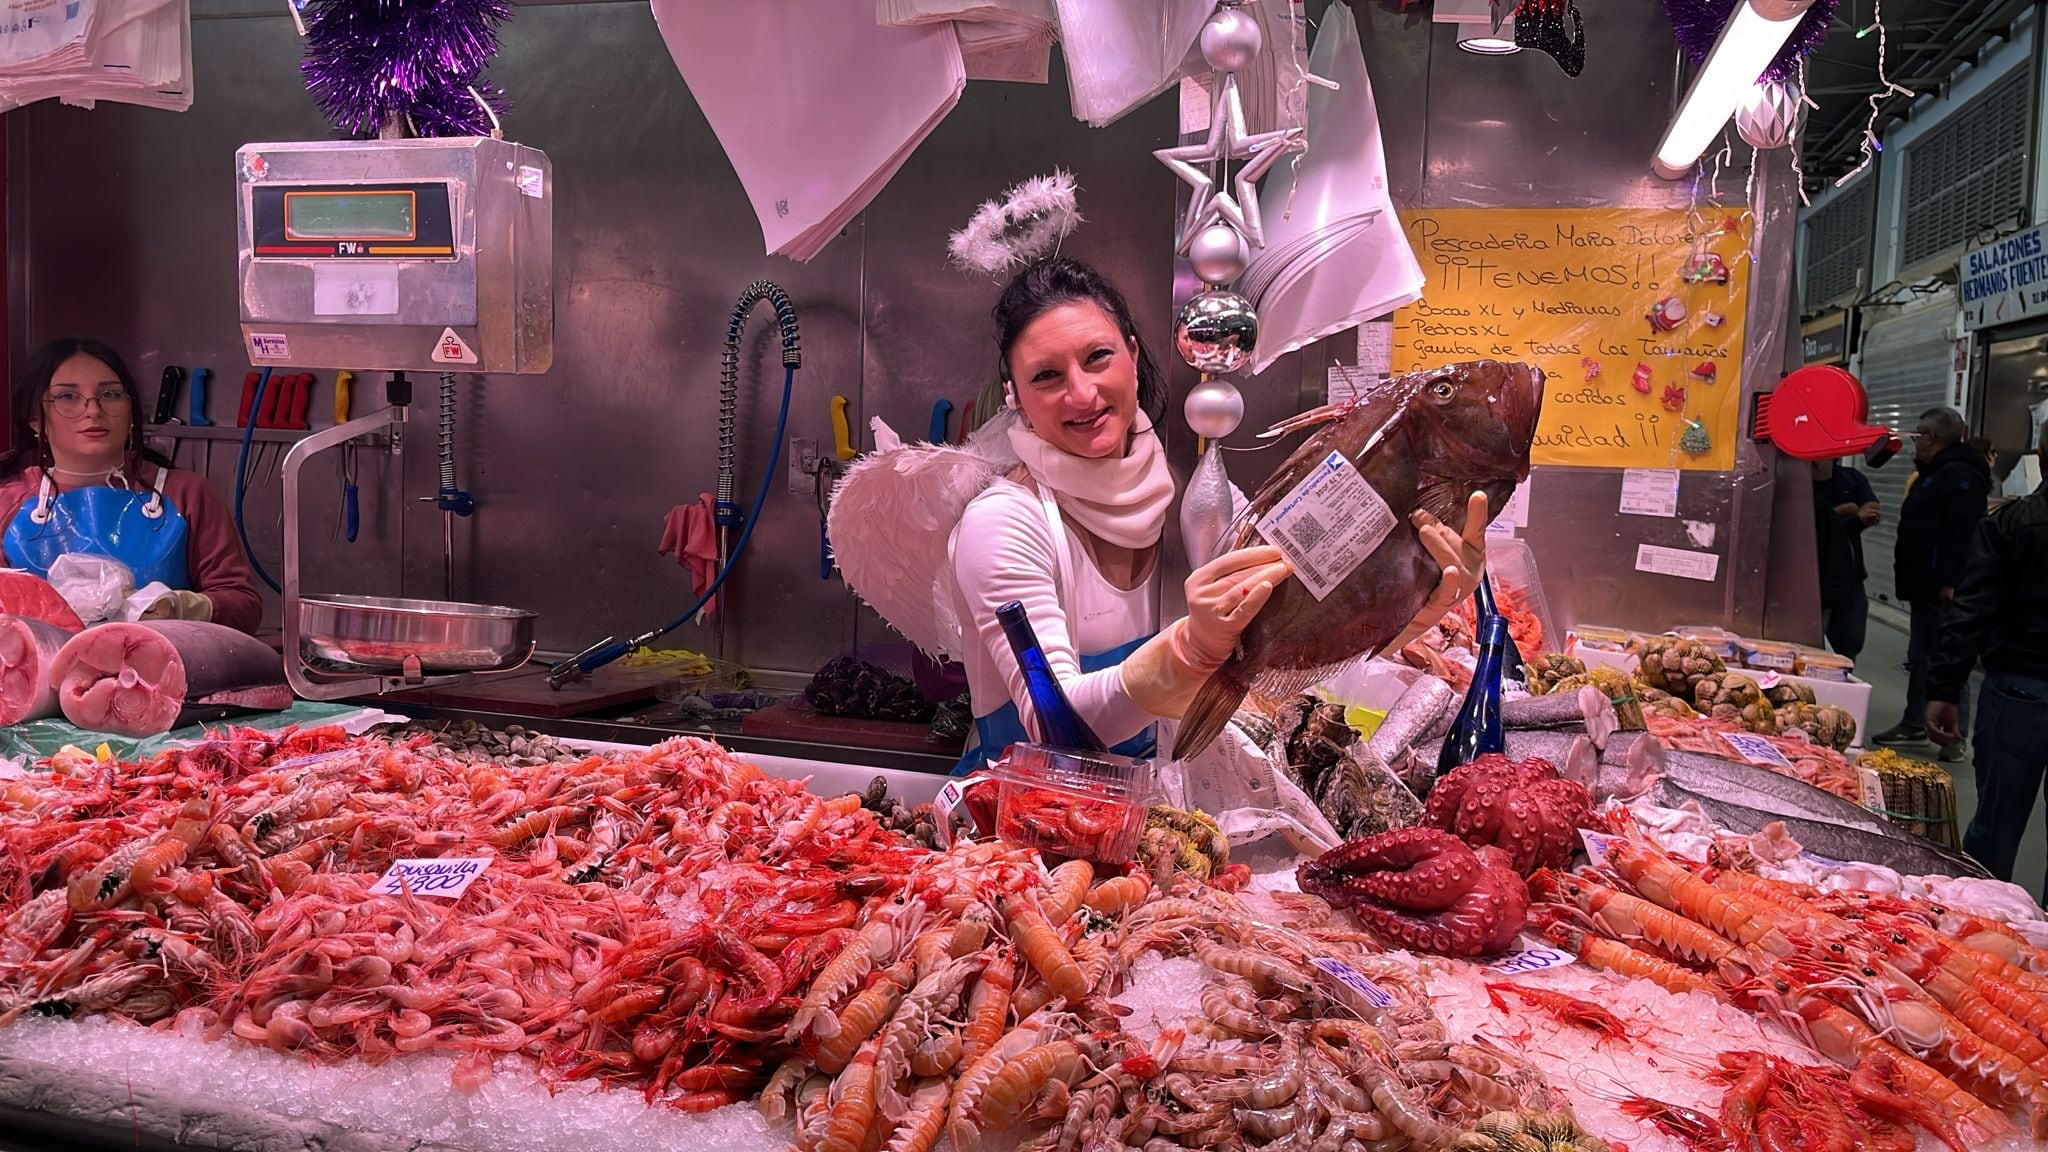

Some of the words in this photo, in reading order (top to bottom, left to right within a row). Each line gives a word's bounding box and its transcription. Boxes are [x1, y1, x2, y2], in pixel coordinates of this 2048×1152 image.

[339, 242, 357, 255] FW
[1970, 230, 2042, 276] SALAZONES
[1963, 268, 2008, 303] HERMANOS
[2010, 255, 2048, 290] FUENTE
[1416, 298, 1471, 316] Bocas
[1479, 303, 1502, 316] XL
[1513, 306, 1524, 320] y
[1533, 300, 1621, 317] Medianas
[1411, 318, 1478, 337] Pechos
[1481, 324, 1510, 337] XL
[444, 346, 459, 356] FW
[1413, 339, 1481, 359] Gamba
[1490, 343, 1518, 356] de
[1555, 388, 1626, 406] cocidos
[1532, 424, 1631, 448] avidad
[1307, 467, 1331, 491] Pescado
[1300, 488, 1310, 498] de
[1272, 494, 1303, 523] Cartagena
[1357, 525, 1366, 533] DE
[1364, 516, 1376, 527] PEZ
[1347, 531, 1359, 543] SAN
[1332, 540, 1349, 558] PEDRO
